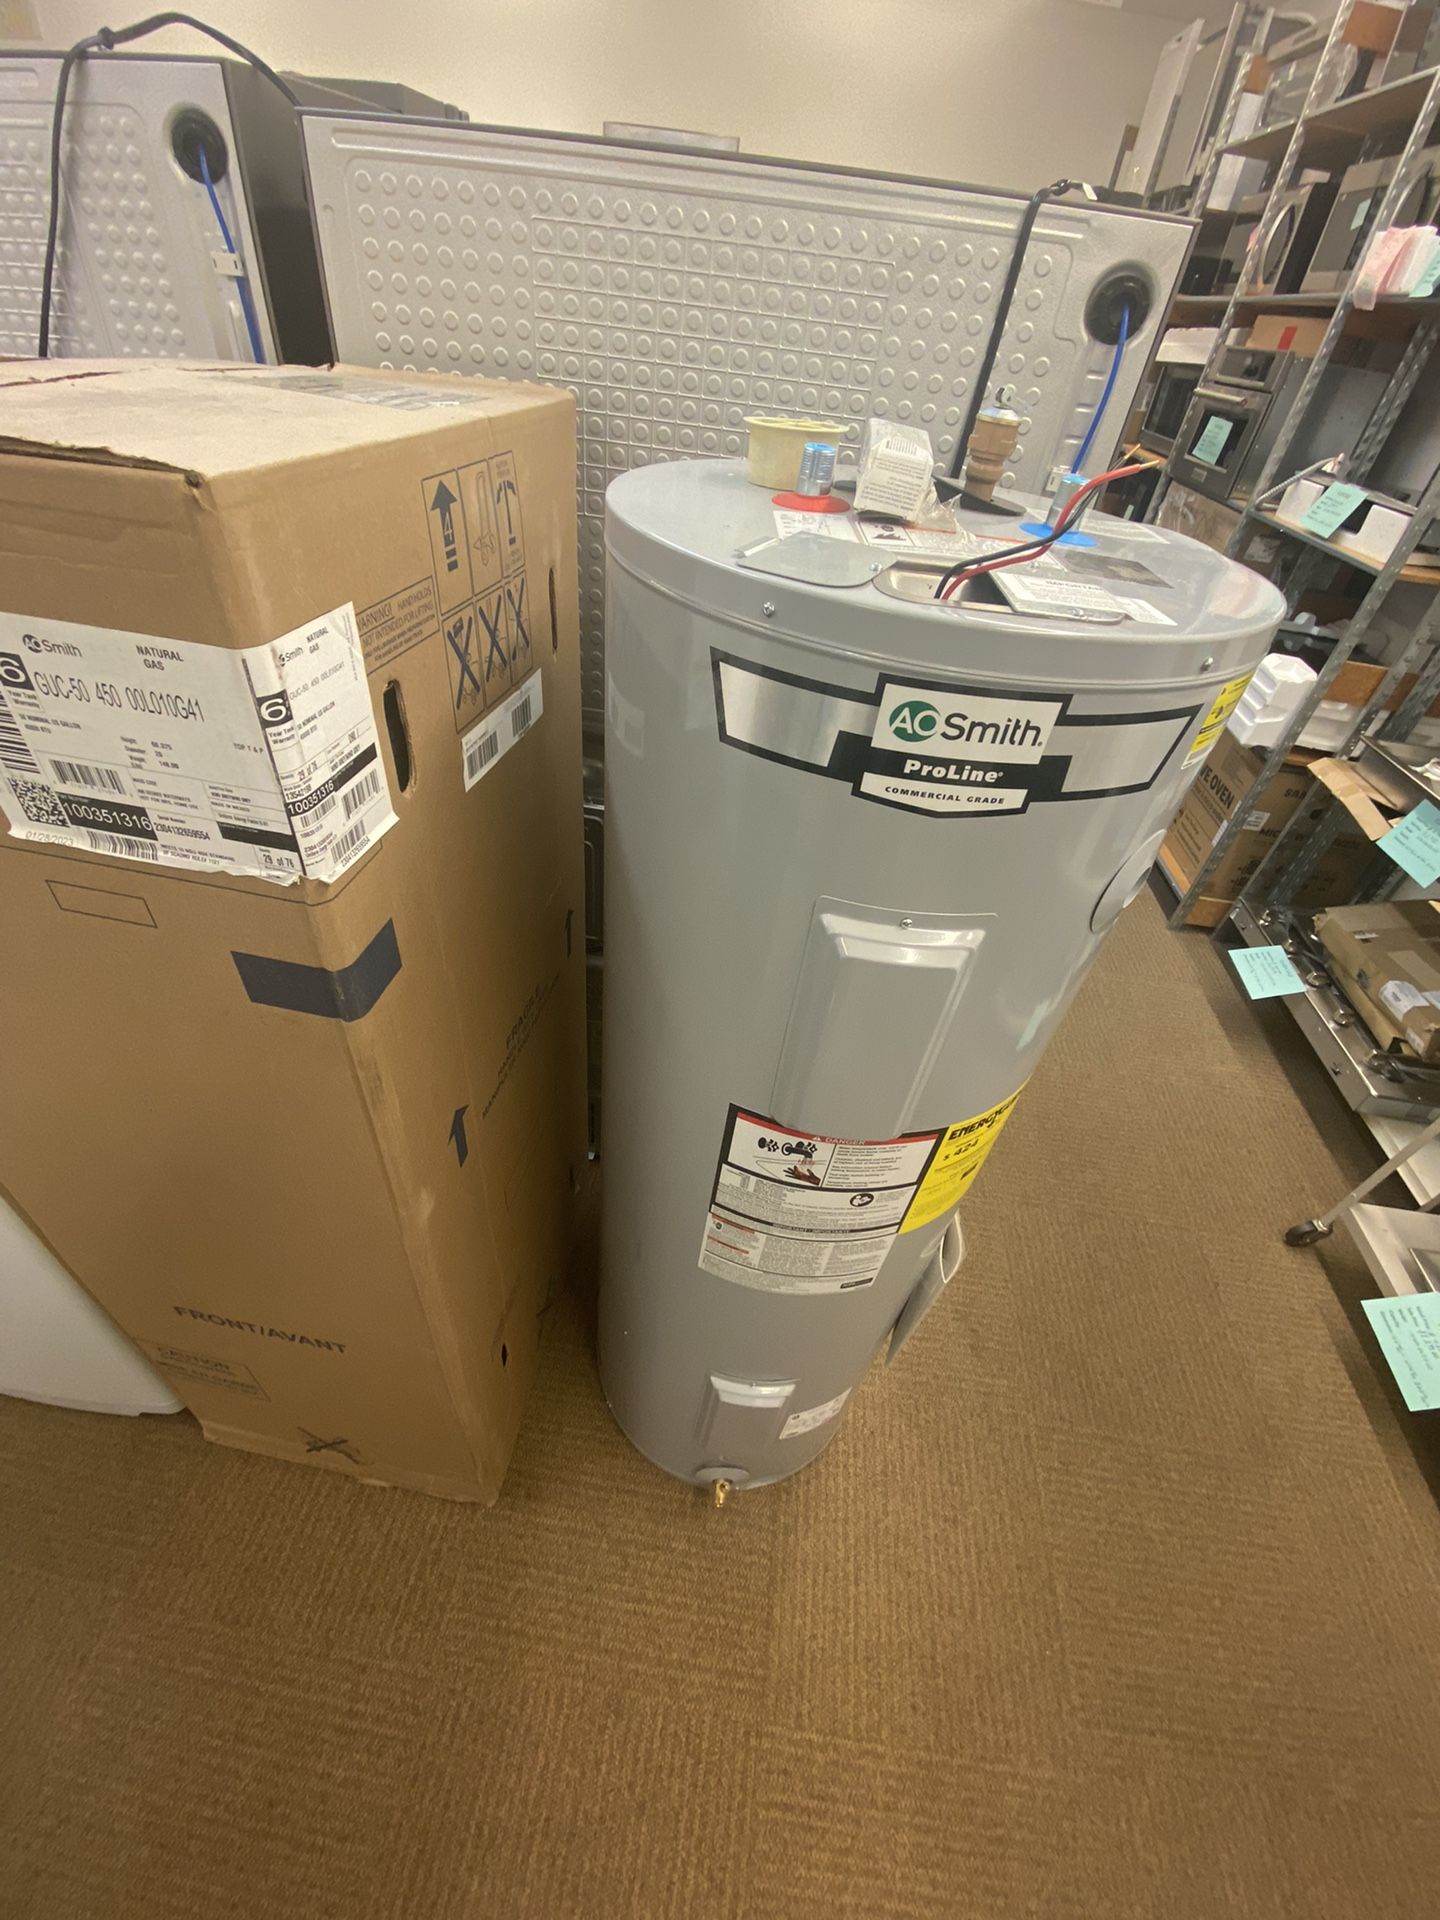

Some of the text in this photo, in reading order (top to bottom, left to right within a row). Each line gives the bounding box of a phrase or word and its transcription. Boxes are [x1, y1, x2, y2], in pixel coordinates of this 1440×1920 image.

[306, 626, 328, 642] NATURAL
[136, 645, 184, 661] NATURAL
[143, 658, 165, 671] GAS
[34, 672, 205, 723] GUC-50 450 00L010G41
[260, 698, 287, 721] 6
[904, 759, 999, 782] ProLine
[287, 780, 334, 814] 100351316
[885, 786, 1004, 804] COMMERCIAL GRADE
[1210, 774, 1235, 809] OVEN
[63, 802, 152, 831] 100351316
[825, 1137, 865, 1145] DANGER
[173, 1305, 346, 1354] FRONT/AVANT
